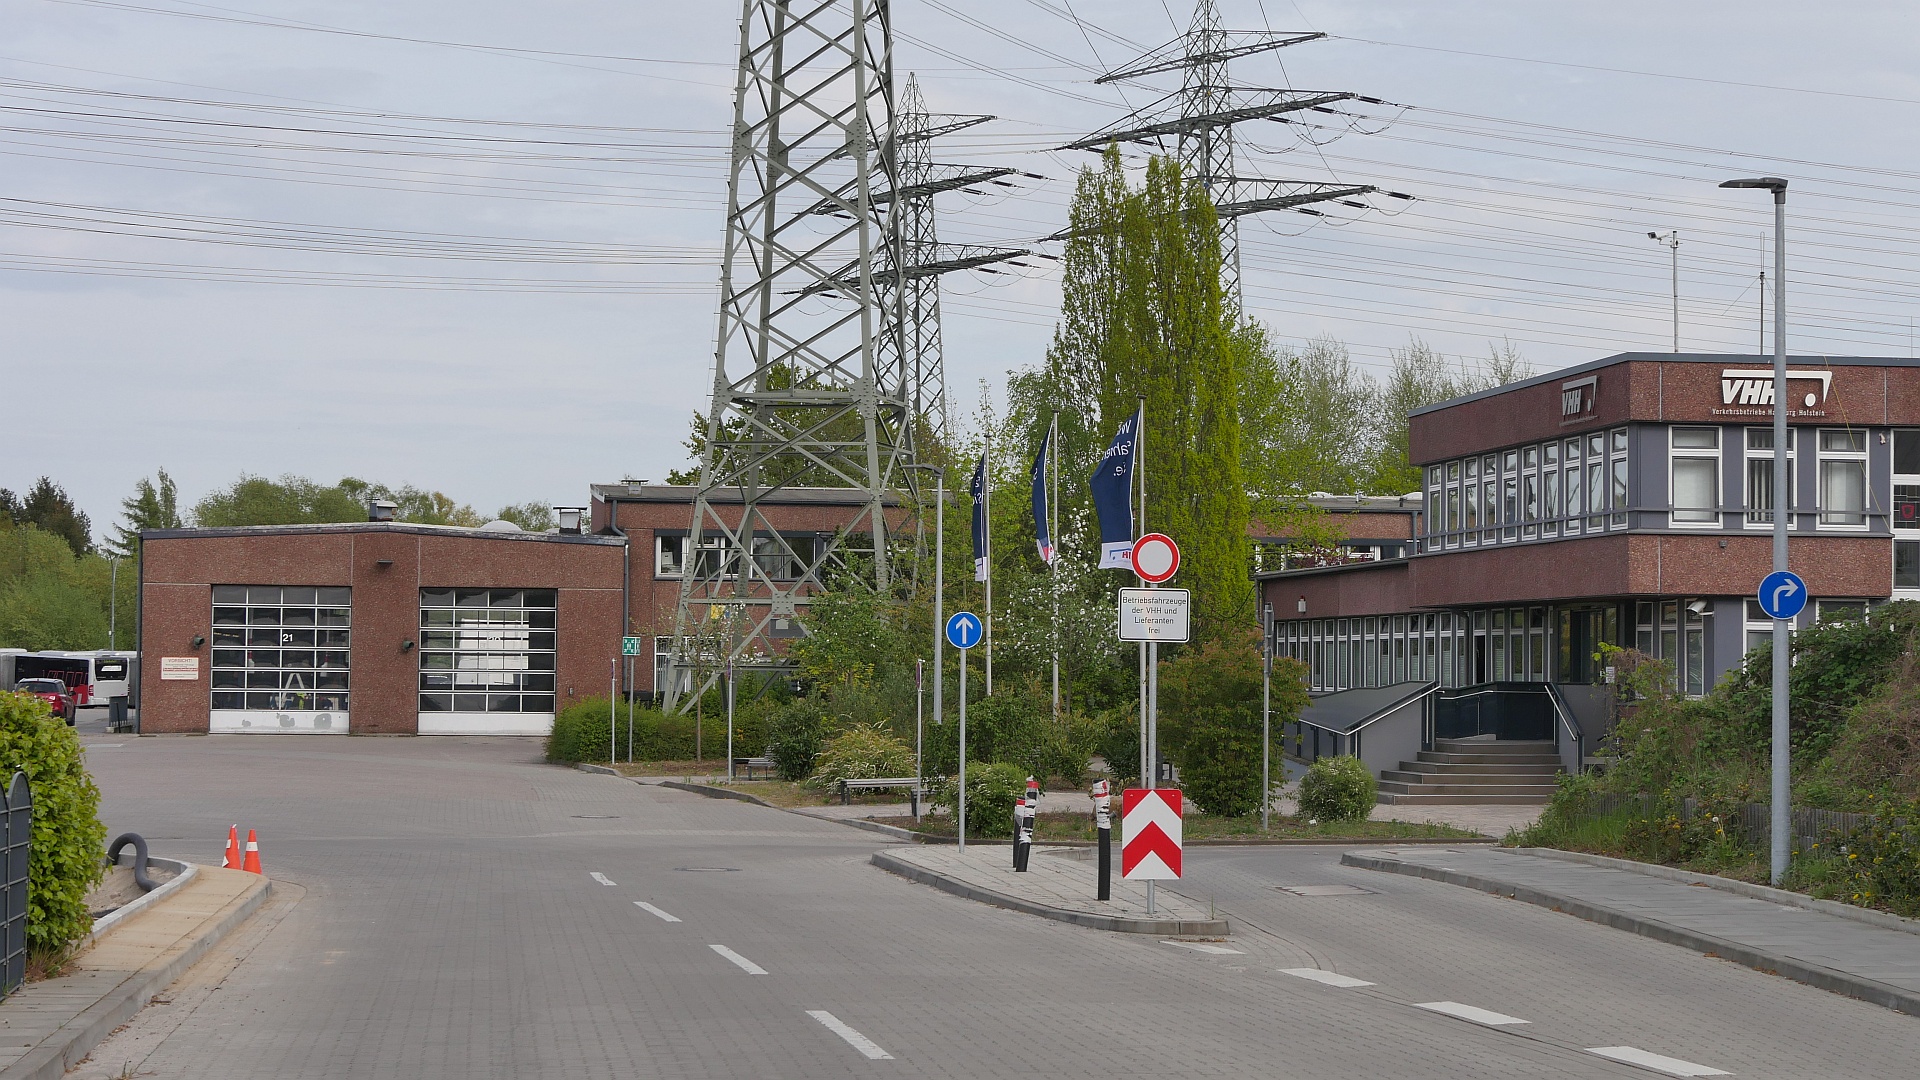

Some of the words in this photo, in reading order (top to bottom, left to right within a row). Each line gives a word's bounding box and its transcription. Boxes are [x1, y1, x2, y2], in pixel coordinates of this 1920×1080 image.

[1562, 388, 1582, 416] VHH
[1711, 408, 1766, 416] Verkehrsbetriebe
[1798, 409, 1825, 417] Holstein
[1122, 596, 1187, 606] Betriebsfahrzeuge
[1164, 607, 1178, 615] und
[1134, 616, 1174, 625] Lieferanten
[1148, 626, 1161, 634] frei
[282, 633, 293, 642] 21
